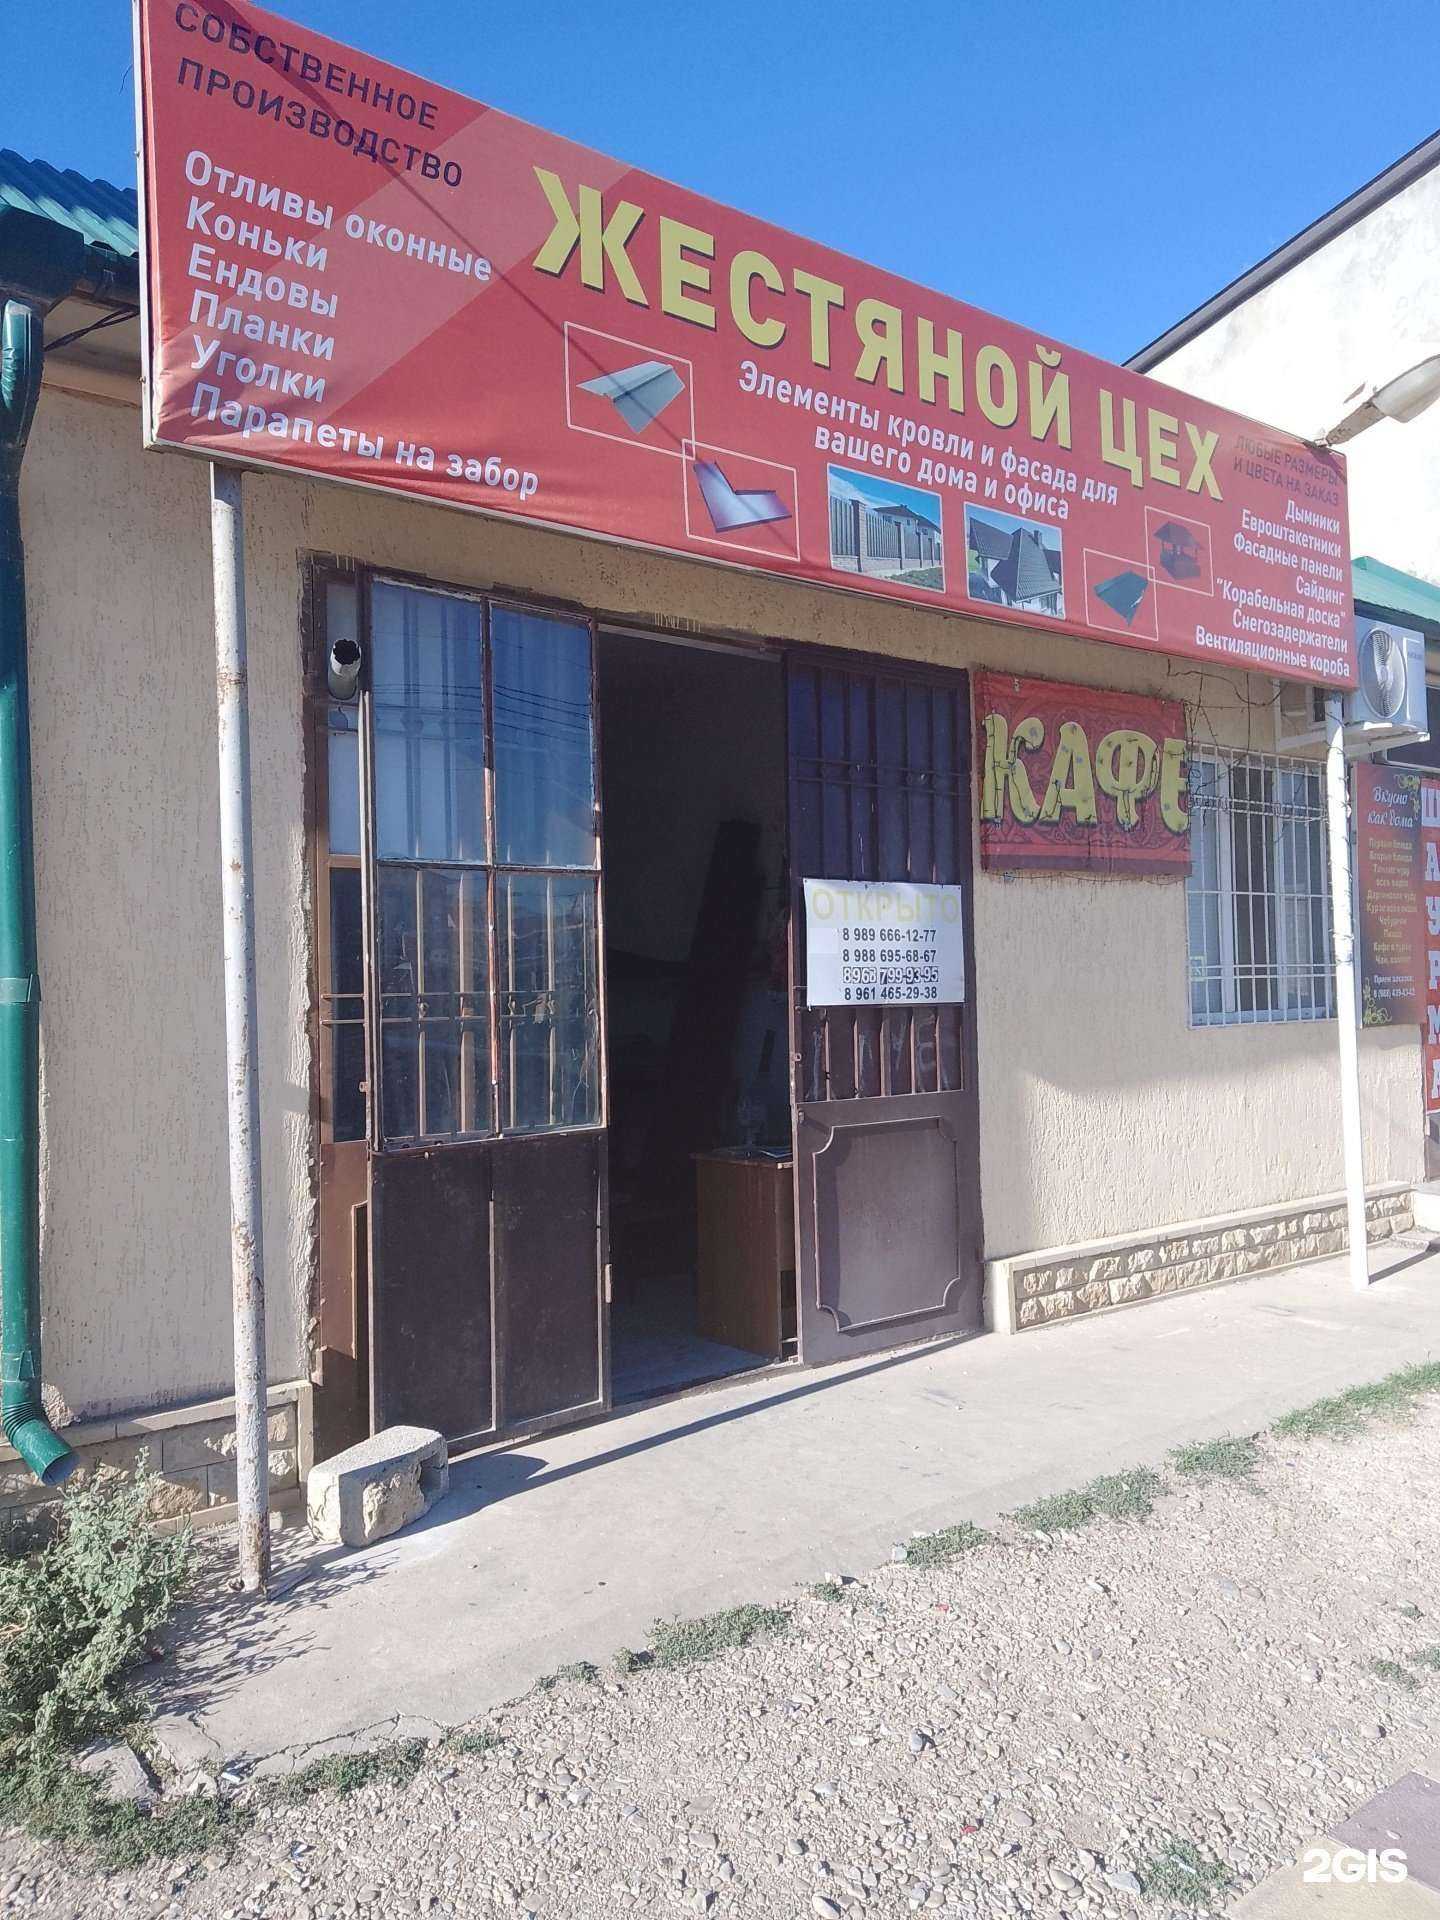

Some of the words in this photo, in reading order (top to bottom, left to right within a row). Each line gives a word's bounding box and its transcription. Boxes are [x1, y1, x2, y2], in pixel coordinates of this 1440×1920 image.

[175, 3, 439, 131] СОБСТВЕННОЕ
[178, 57, 463, 188] ПРОИЗВОДСТВО
[185, 150, 334, 230] Отливы
[345, 213, 493, 281] оконные
[186, 195, 328, 272] Коньки
[188, 243, 338, 318] Ендовы
[189, 289, 335, 361] Планки
[532, 165, 1073, 451] ЖЕСТЯНОЙ
[1100, 387, 1223, 501] ЦЕХ
[191, 334, 326, 402] Уголки
[191, 381, 384, 459] Парапеты
[396, 440, 436, 471] на
[446, 453, 540, 501] забор
[738, 360, 880, 431] Элементы
[887, 414, 974, 460] кровли
[980, 442, 994, 467] и
[1000, 446, 1077, 494] фасада
[1082, 476, 1119, 506] для
[1234, 435, 1282, 465] ЛЮБЫЕ
[1284, 453, 1339, 486] РАЗМЕРЫ
[814, 426, 911, 474] вашего
[917, 457, 977, 494] дома
[984, 475, 998, 499] и
[1004, 480, 1070, 520] офиса
[1233, 456, 1242, 473] И
[1246, 459, 1283, 488] ЦВЕТА
[1286, 476, 1301, 494] НА
[1304, 483, 1339, 506] ЗАКАЗ
[1241, 508, 1342, 558] Евроштакетники
[1285, 499, 1341, 535] Дымники
[1233, 531, 1299, 568] Фасадные
[1301, 556, 1344, 582] панели
[1296, 575, 1345, 606] Сайдинг
[1195, 625, 1308, 668] Вентиляционные
[1310, 654, 1351, 678] короба
[1233, 608, 1348, 654] Снегозадержатели
[981, 712, 1189, 835] КАФЕ
[812, 888, 960, 924] ОТКРЫТО
[843, 927, 850, 941] 8
[854, 927, 875, 942] 989
[880, 928, 937, 943] 666-12-77
[843, 949, 850, 962] 8
[854, 949, 876, 962] 988
[880, 949, 937, 963] 695-68-67
[844, 987, 851, 1001] 8
[855, 987, 876, 1000] 961
[880, 986, 938, 1000] 465-29-38
